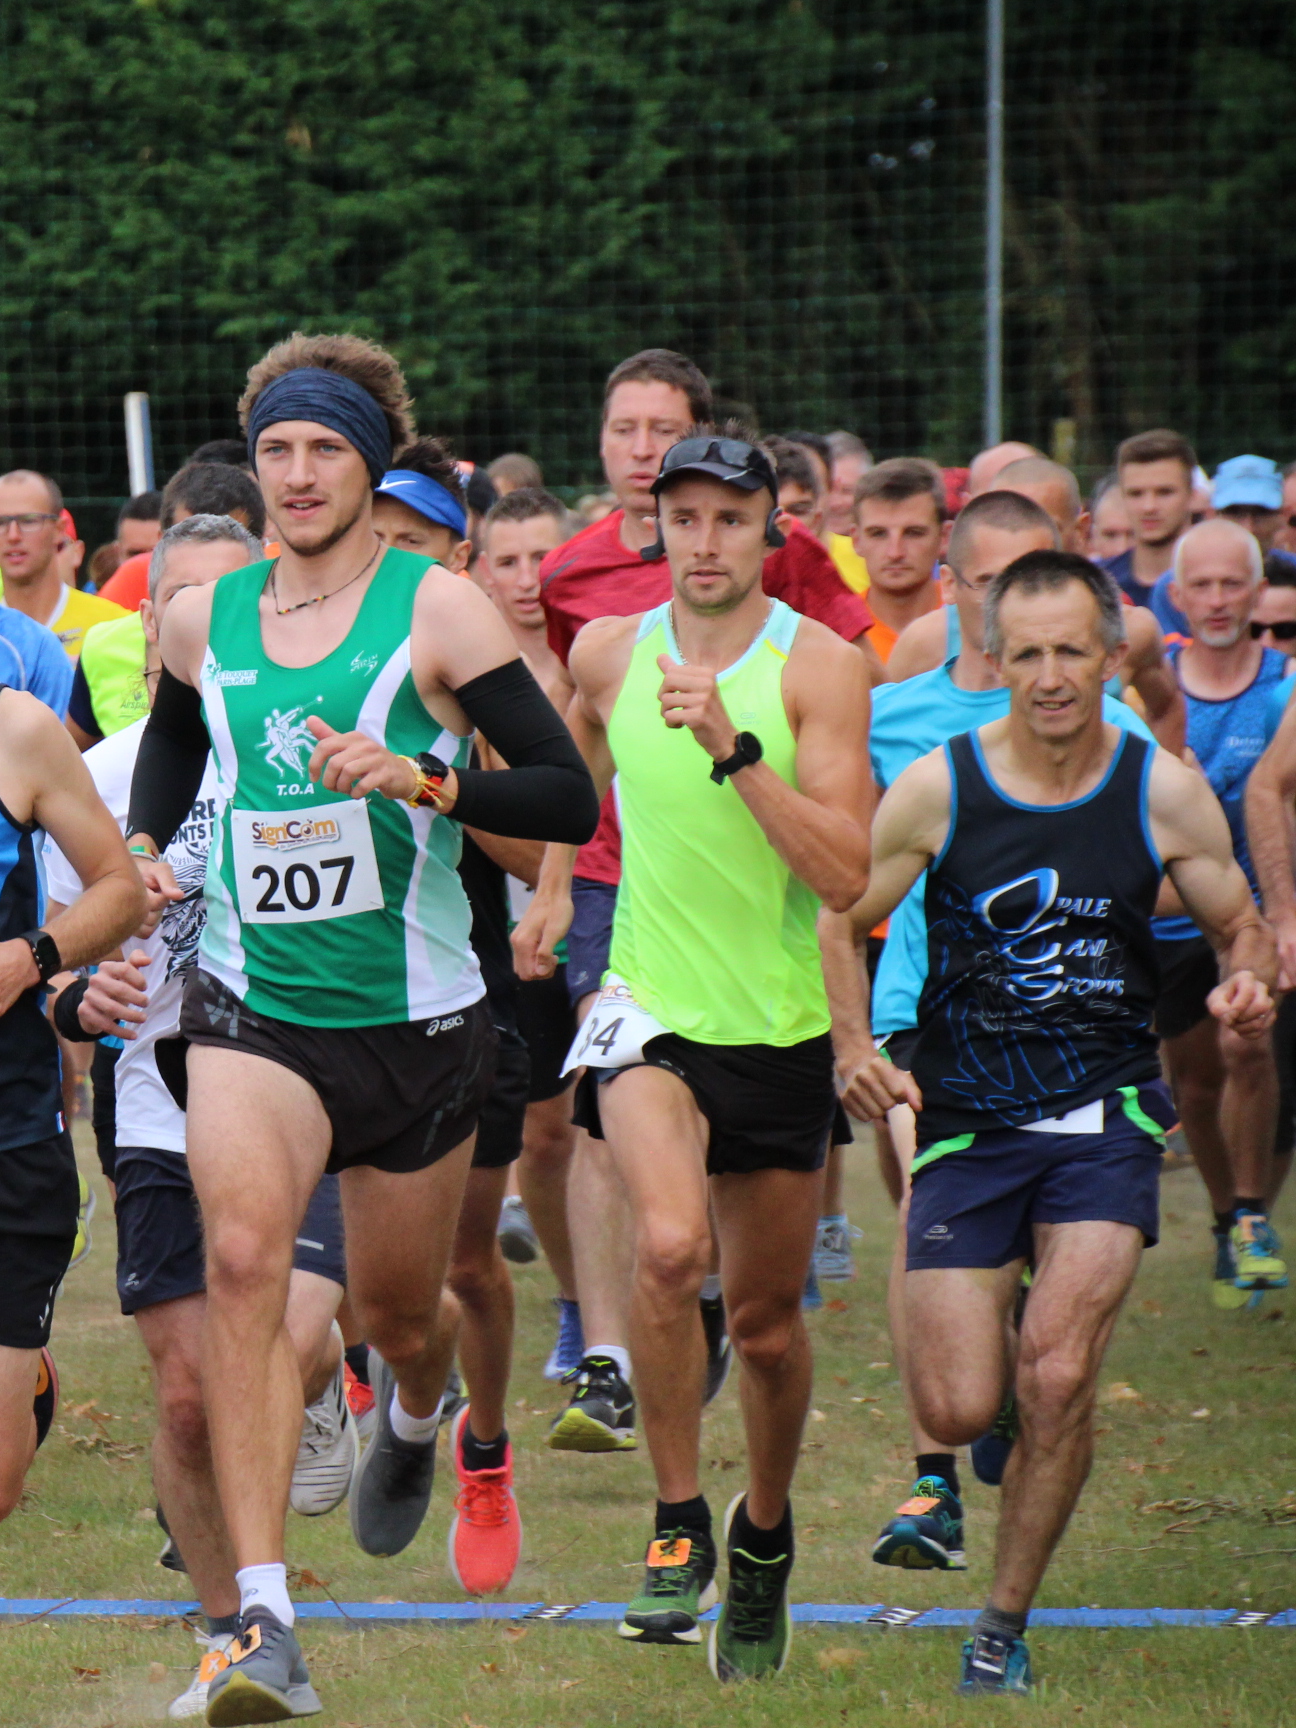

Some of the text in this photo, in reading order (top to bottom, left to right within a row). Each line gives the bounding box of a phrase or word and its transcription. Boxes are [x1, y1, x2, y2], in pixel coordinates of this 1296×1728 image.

[224, 669, 258, 678] TOUQUET
[277, 783, 314, 796] T.O.A
[252, 856, 355, 912] 207
